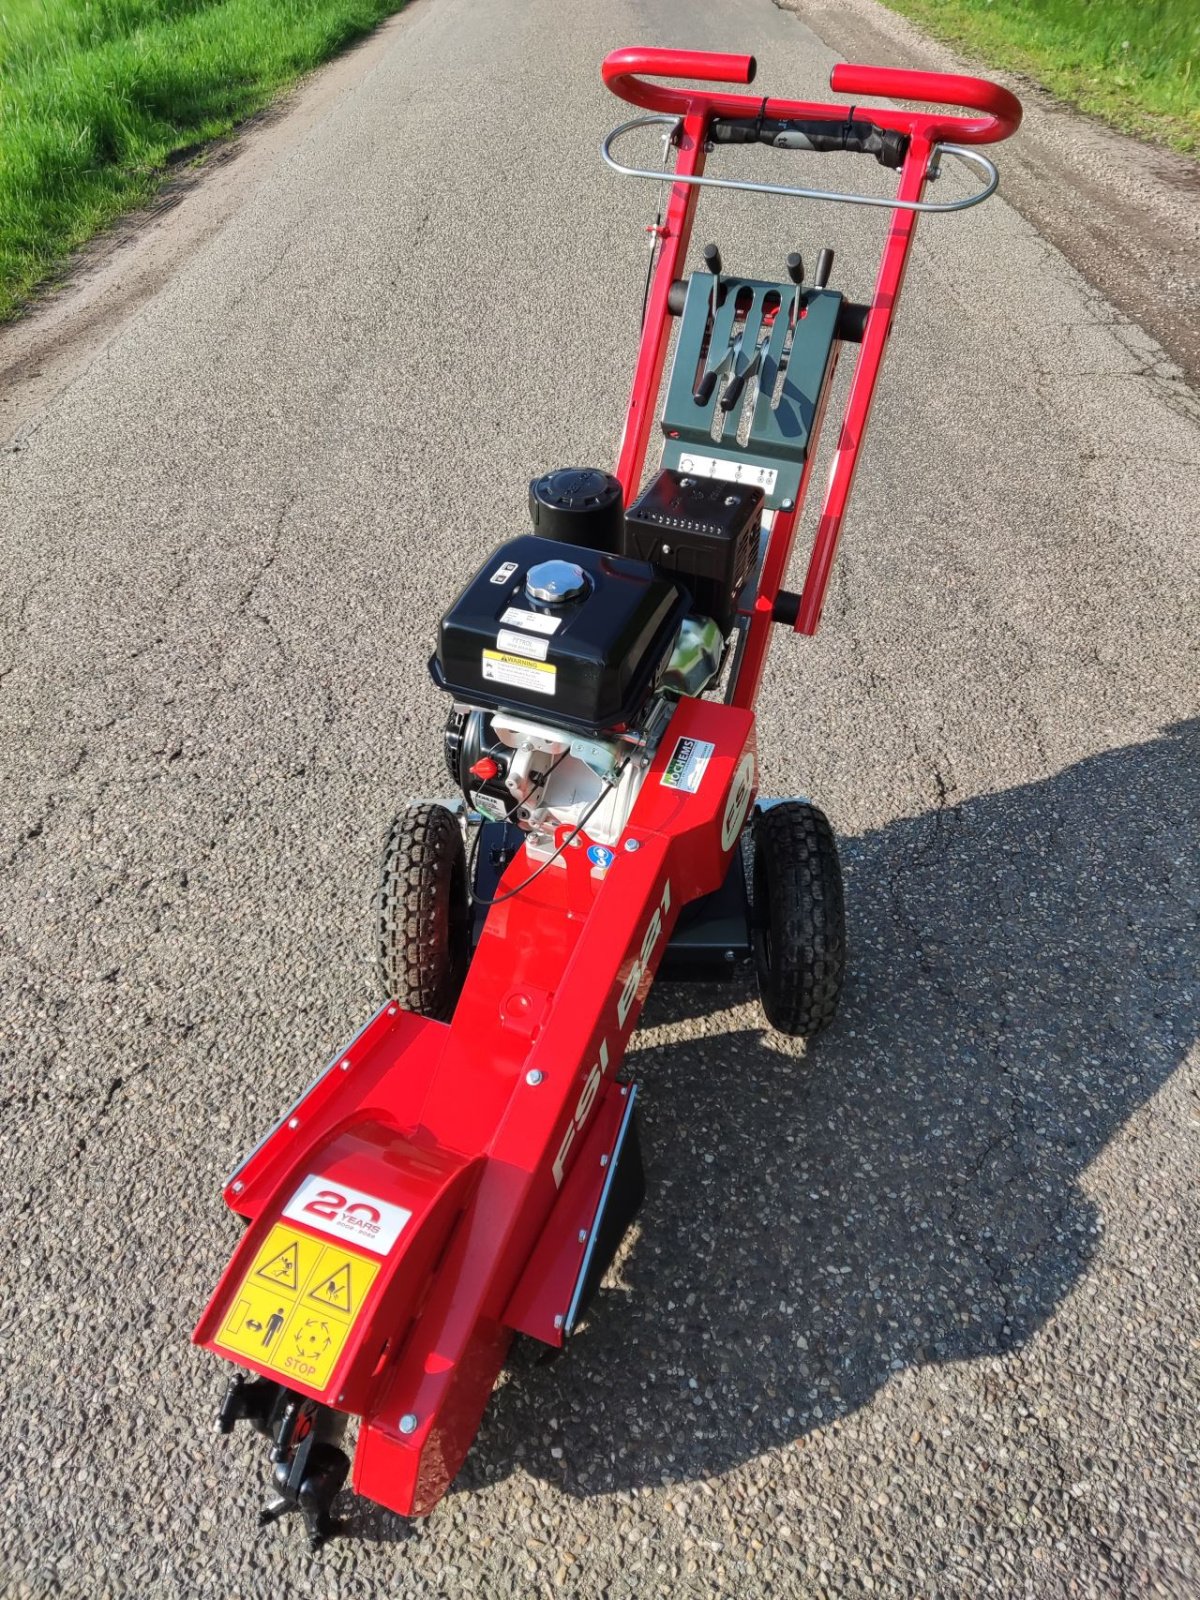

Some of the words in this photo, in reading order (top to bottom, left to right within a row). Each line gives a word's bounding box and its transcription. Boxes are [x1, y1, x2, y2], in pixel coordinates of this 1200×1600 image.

[507, 655, 538, 668] WARNING
[669, 740, 694, 786] JOCHEMS
[552, 1037, 609, 1191] FSI
[617, 878, 671, 1031] B21
[303, 1190, 381, 1222] 20
[340, 1213, 381, 1234] YEARS
[284, 1356, 316, 1376] STOP
